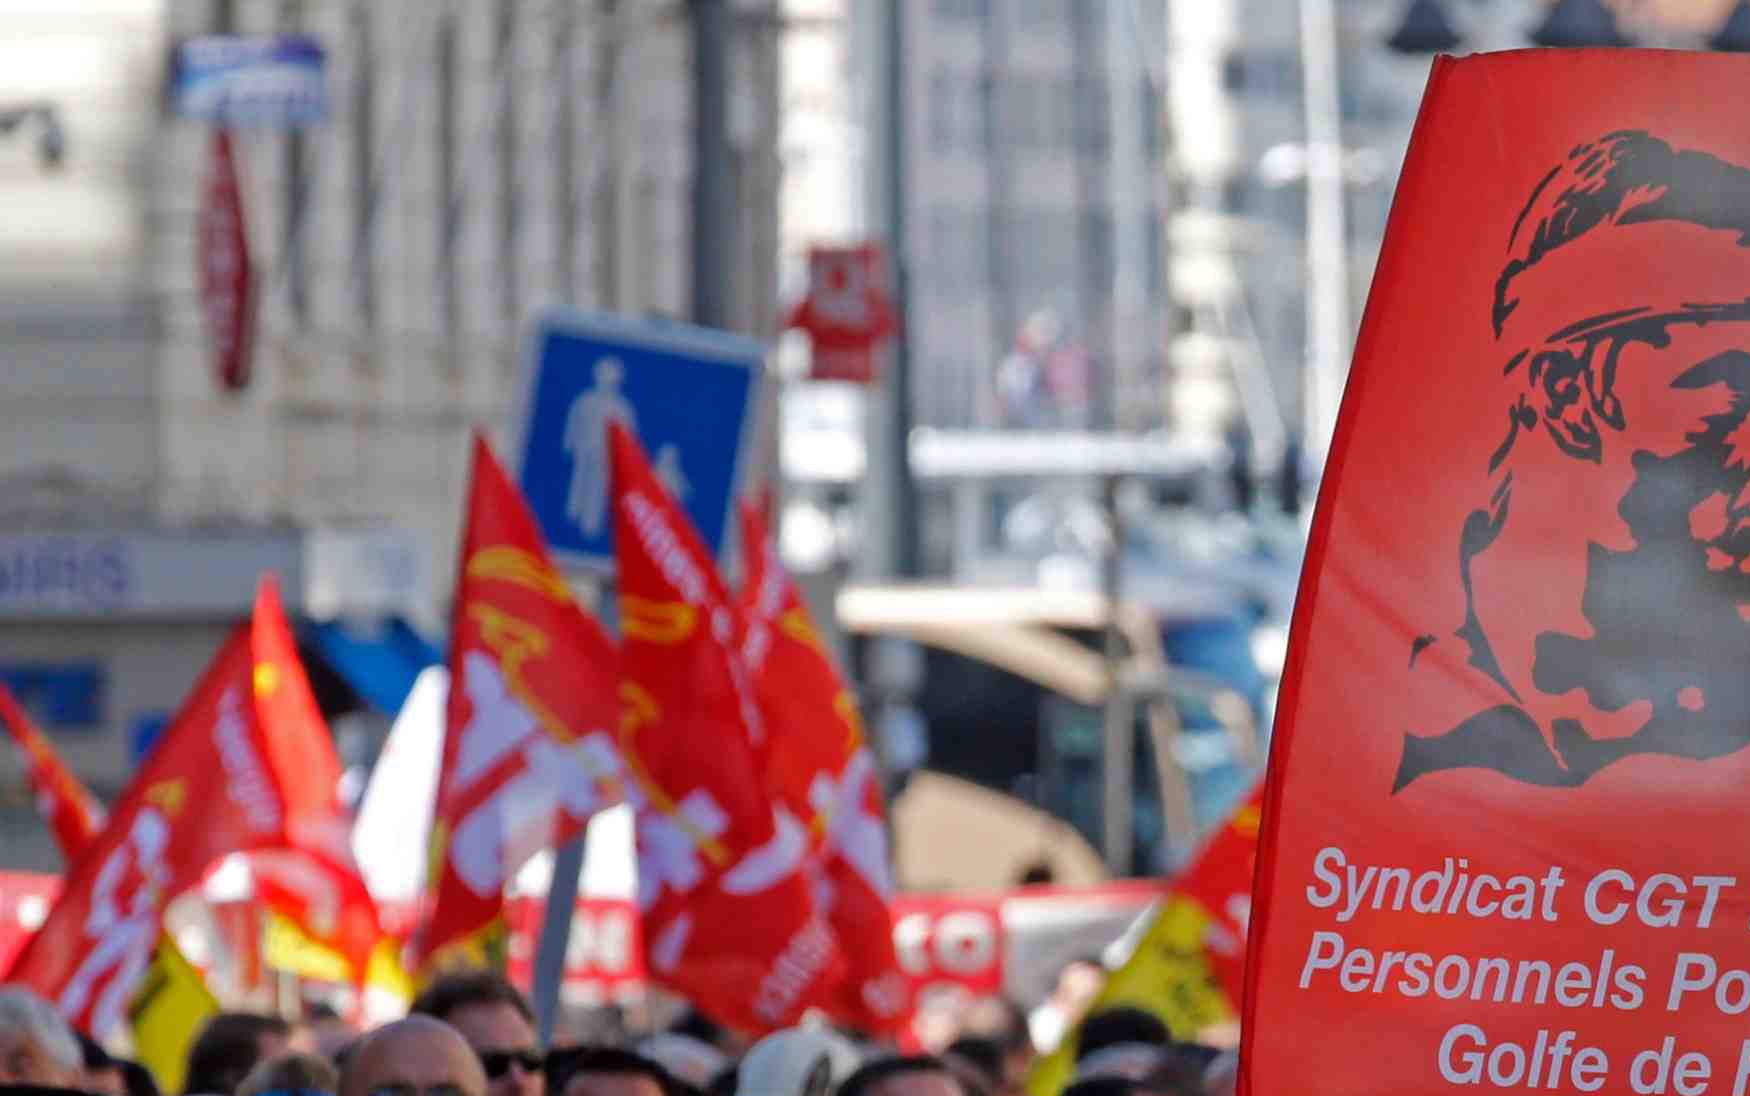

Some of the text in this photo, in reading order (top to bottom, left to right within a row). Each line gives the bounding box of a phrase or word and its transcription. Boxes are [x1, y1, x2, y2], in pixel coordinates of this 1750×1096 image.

[1306, 847, 1565, 922] Syndicat
[1584, 868, 1736, 928] CGT
[1299, 931, 1647, 1010] Personnels
[1438, 1023, 1608, 1092] Golfe
[1630, 1036, 1712, 1096] de
